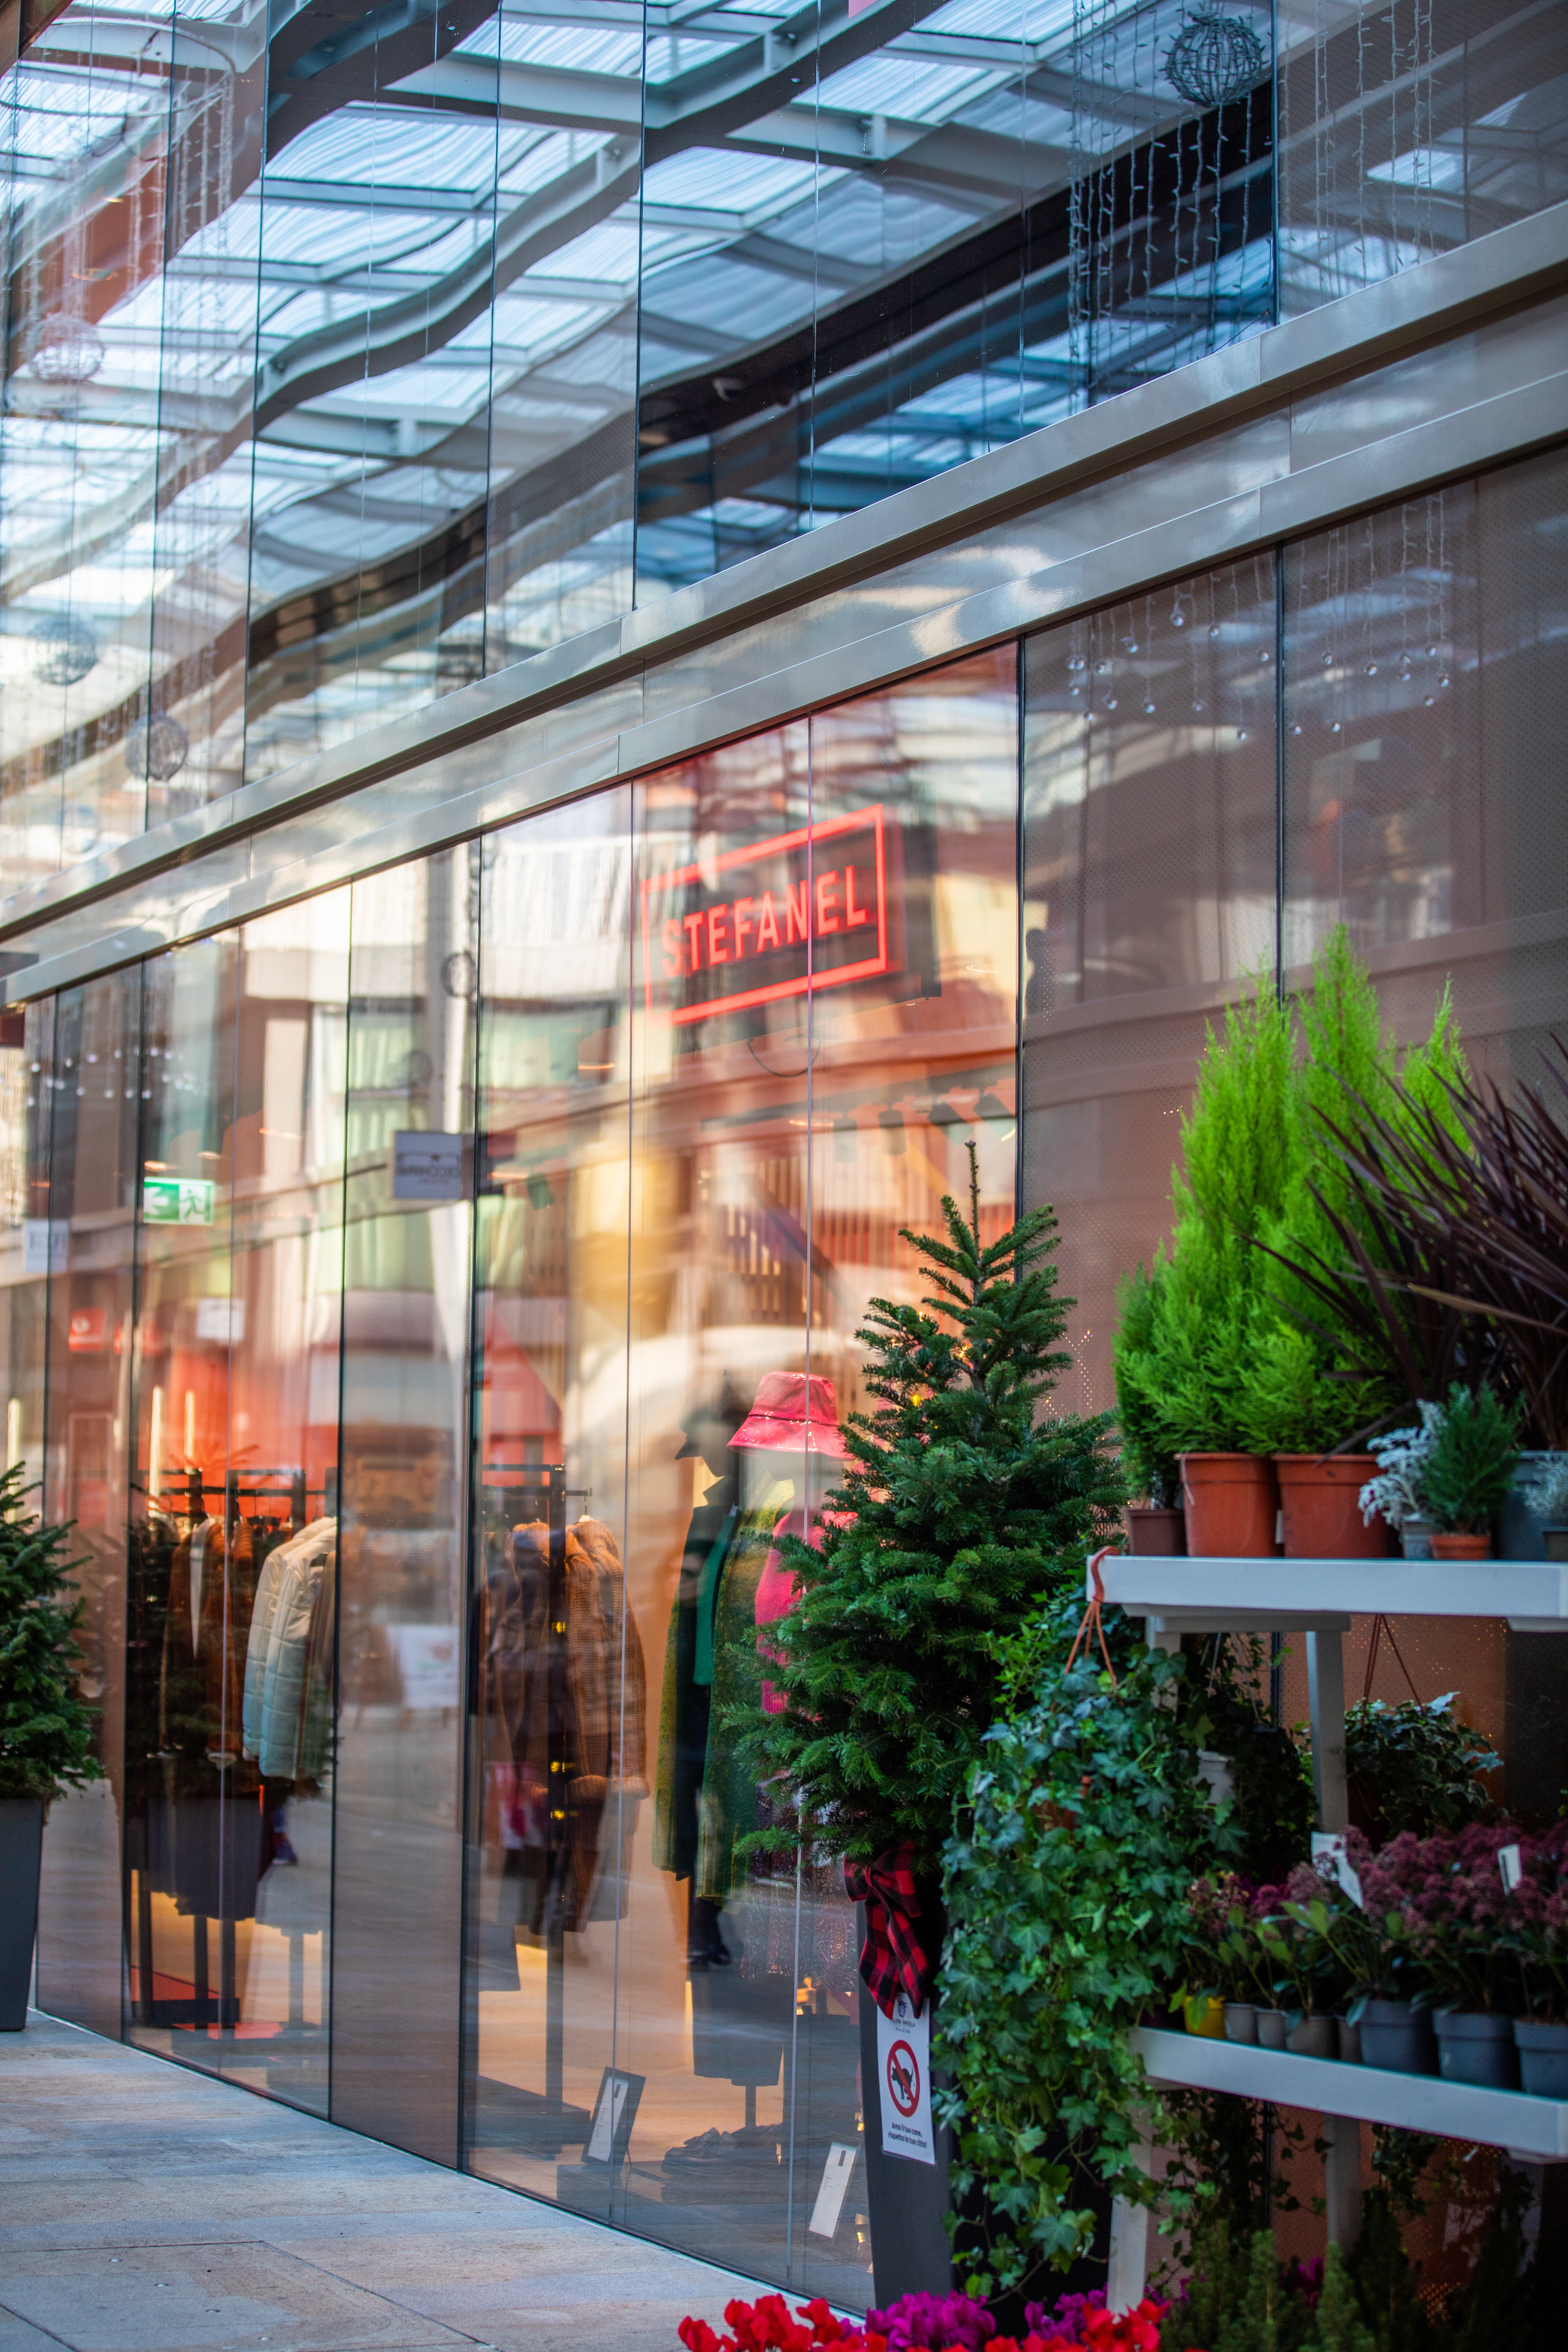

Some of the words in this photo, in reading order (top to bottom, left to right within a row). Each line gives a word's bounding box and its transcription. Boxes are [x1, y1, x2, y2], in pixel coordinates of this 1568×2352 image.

[662, 865, 867, 978] STEFANEL
[888, 2130, 904, 2141] rispetta
[904, 2134, 909, 2143] la
[892, 2122, 901, 2130] Ama
[911, 2129, 922, 2137] cane,
